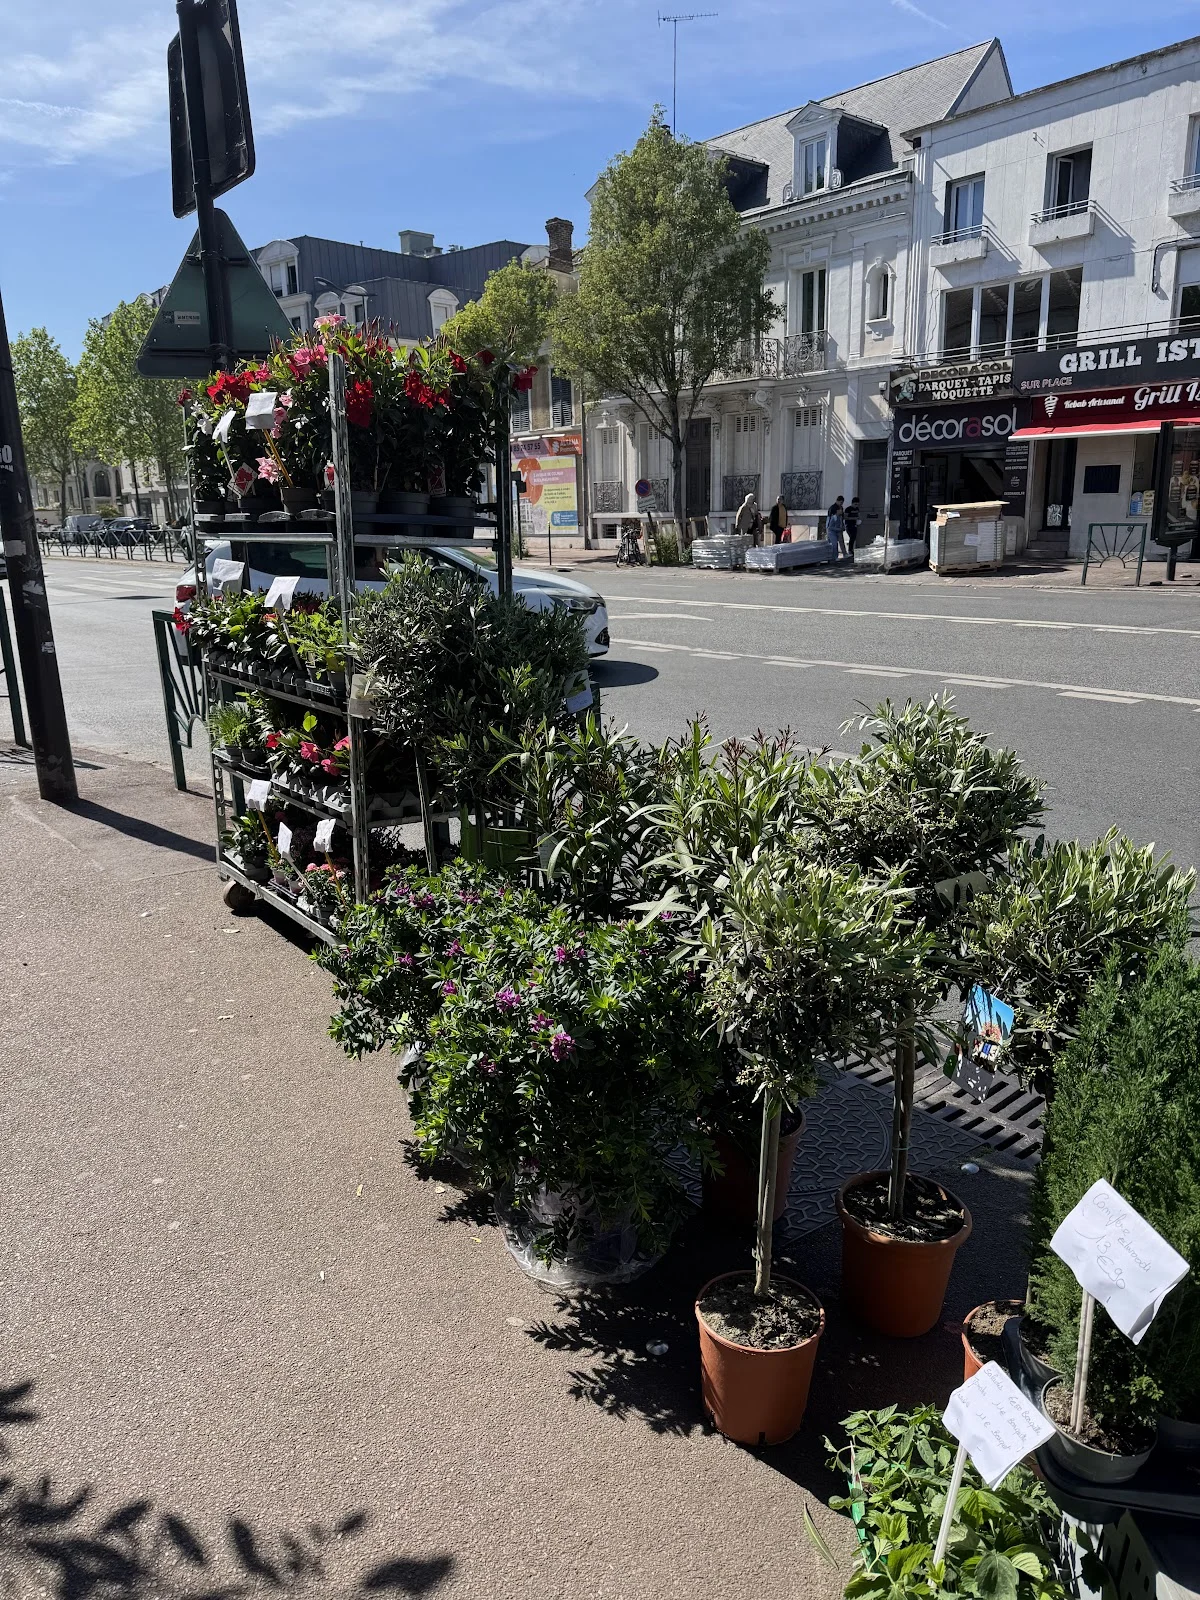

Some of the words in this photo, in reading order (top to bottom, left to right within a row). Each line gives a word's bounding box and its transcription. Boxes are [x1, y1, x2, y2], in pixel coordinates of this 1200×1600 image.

[1059, 345, 1142, 374] GRILL
[920, 362, 1011, 379] DECORASOL
[918, 378, 969, 393] PARQUET
[978, 374, 1012, 386] TAPIS
[1020, 379, 1041, 390] SUR
[1042, 376, 1073, 388] PLACE
[932, 386, 994, 400] MOQUETTE
[1133, 384, 1183, 411] Grill
[1064, 399, 1087, 409] Kebab
[1087, 396, 1126, 408] Artisanal
[898, 406, 1017, 443] décorasol
